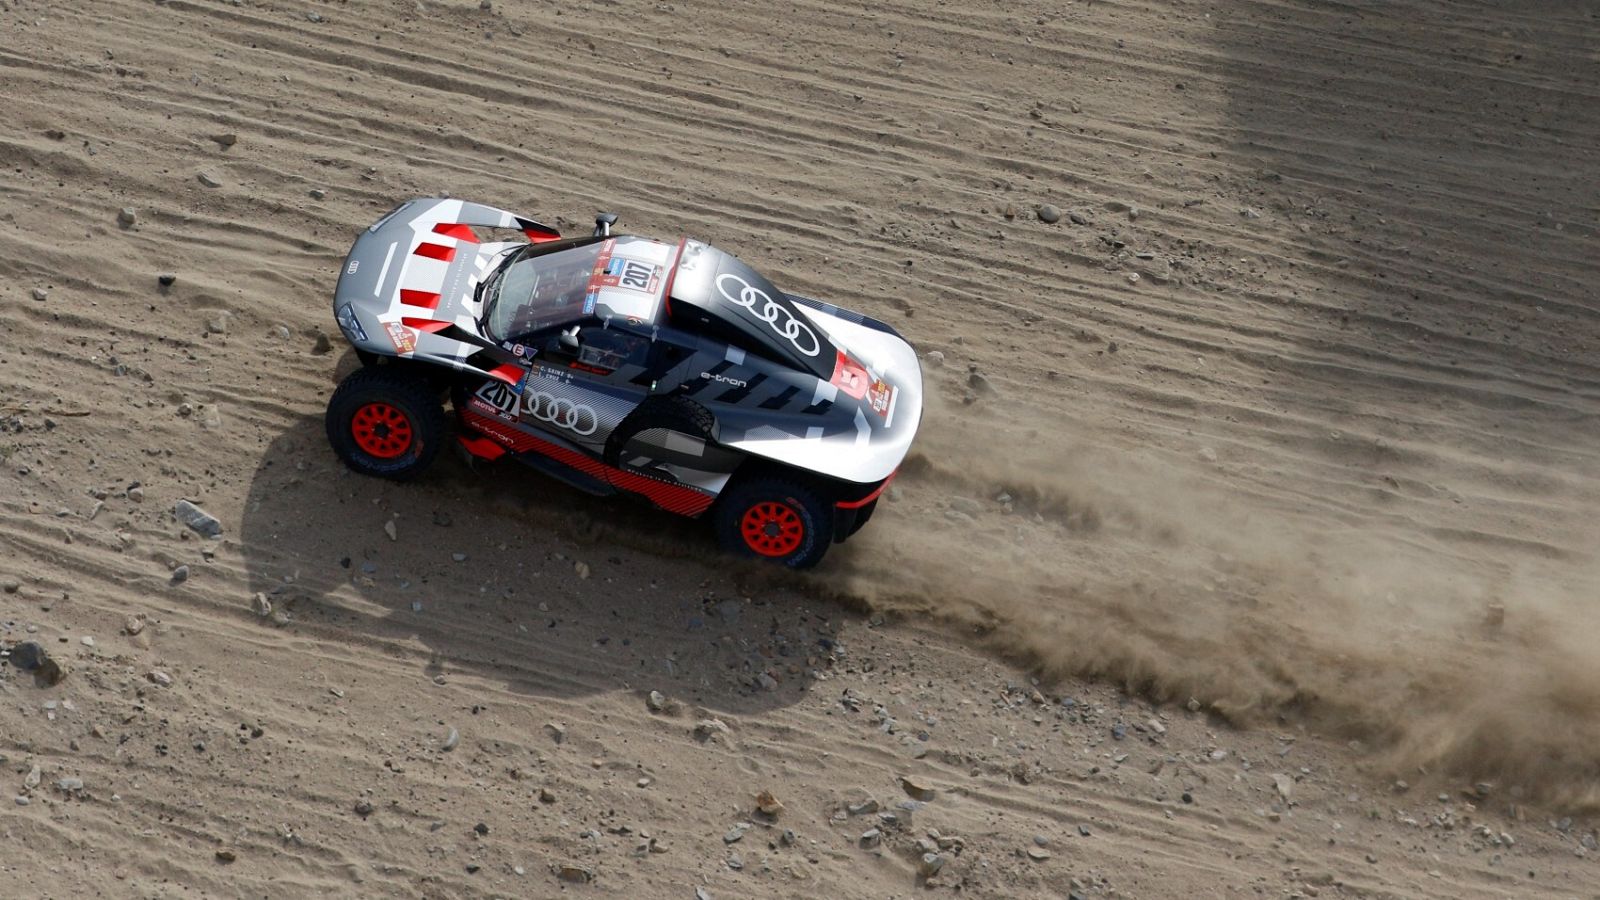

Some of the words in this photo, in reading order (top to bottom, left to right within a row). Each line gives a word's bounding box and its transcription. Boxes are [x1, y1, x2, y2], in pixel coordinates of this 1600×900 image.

[622, 262, 652, 289] 207
[700, 371, 747, 388] e-tron
[473, 399, 497, 413] MOTUL
[480, 380, 517, 413] 207
[471, 421, 514, 444] e-tron
